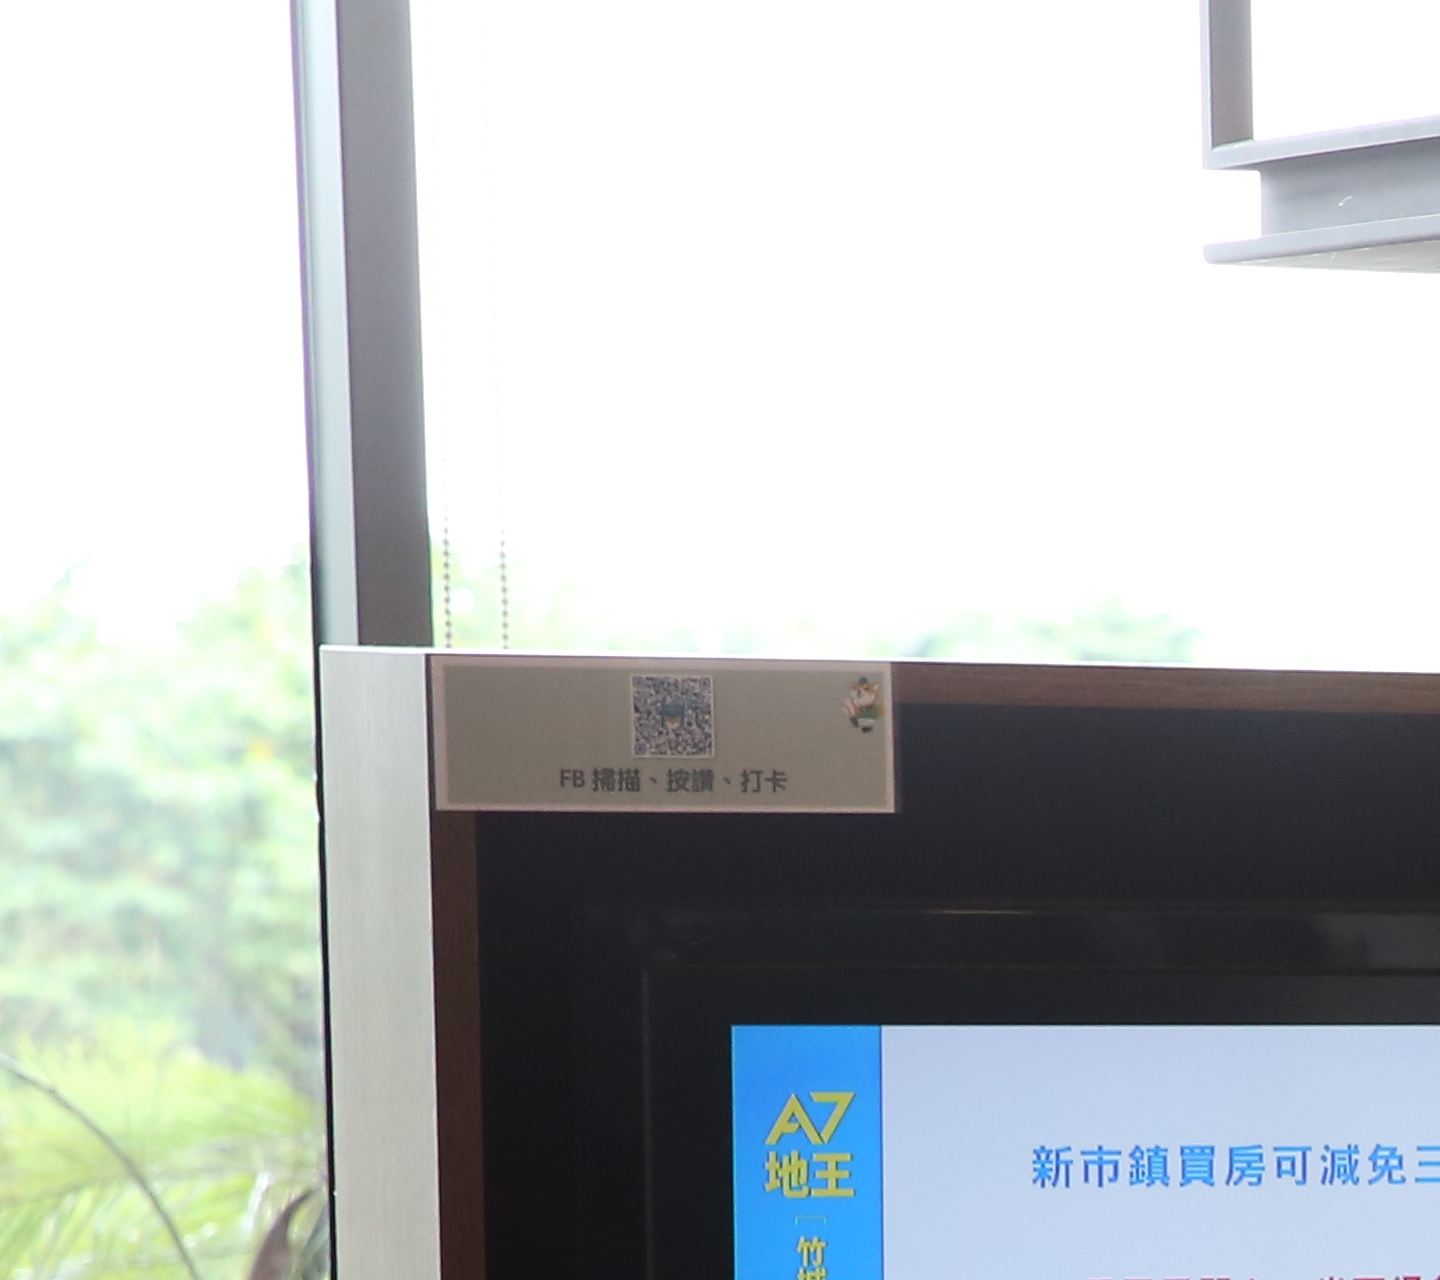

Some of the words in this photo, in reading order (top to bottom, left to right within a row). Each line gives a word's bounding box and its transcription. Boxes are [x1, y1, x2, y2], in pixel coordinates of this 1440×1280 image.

[560, 770, 585, 789] FB
[592, 768, 788, 793] 掃描、按讚、打卡
[764, 1091, 855, 1146] A7
[764, 1149, 855, 1198] 地王
